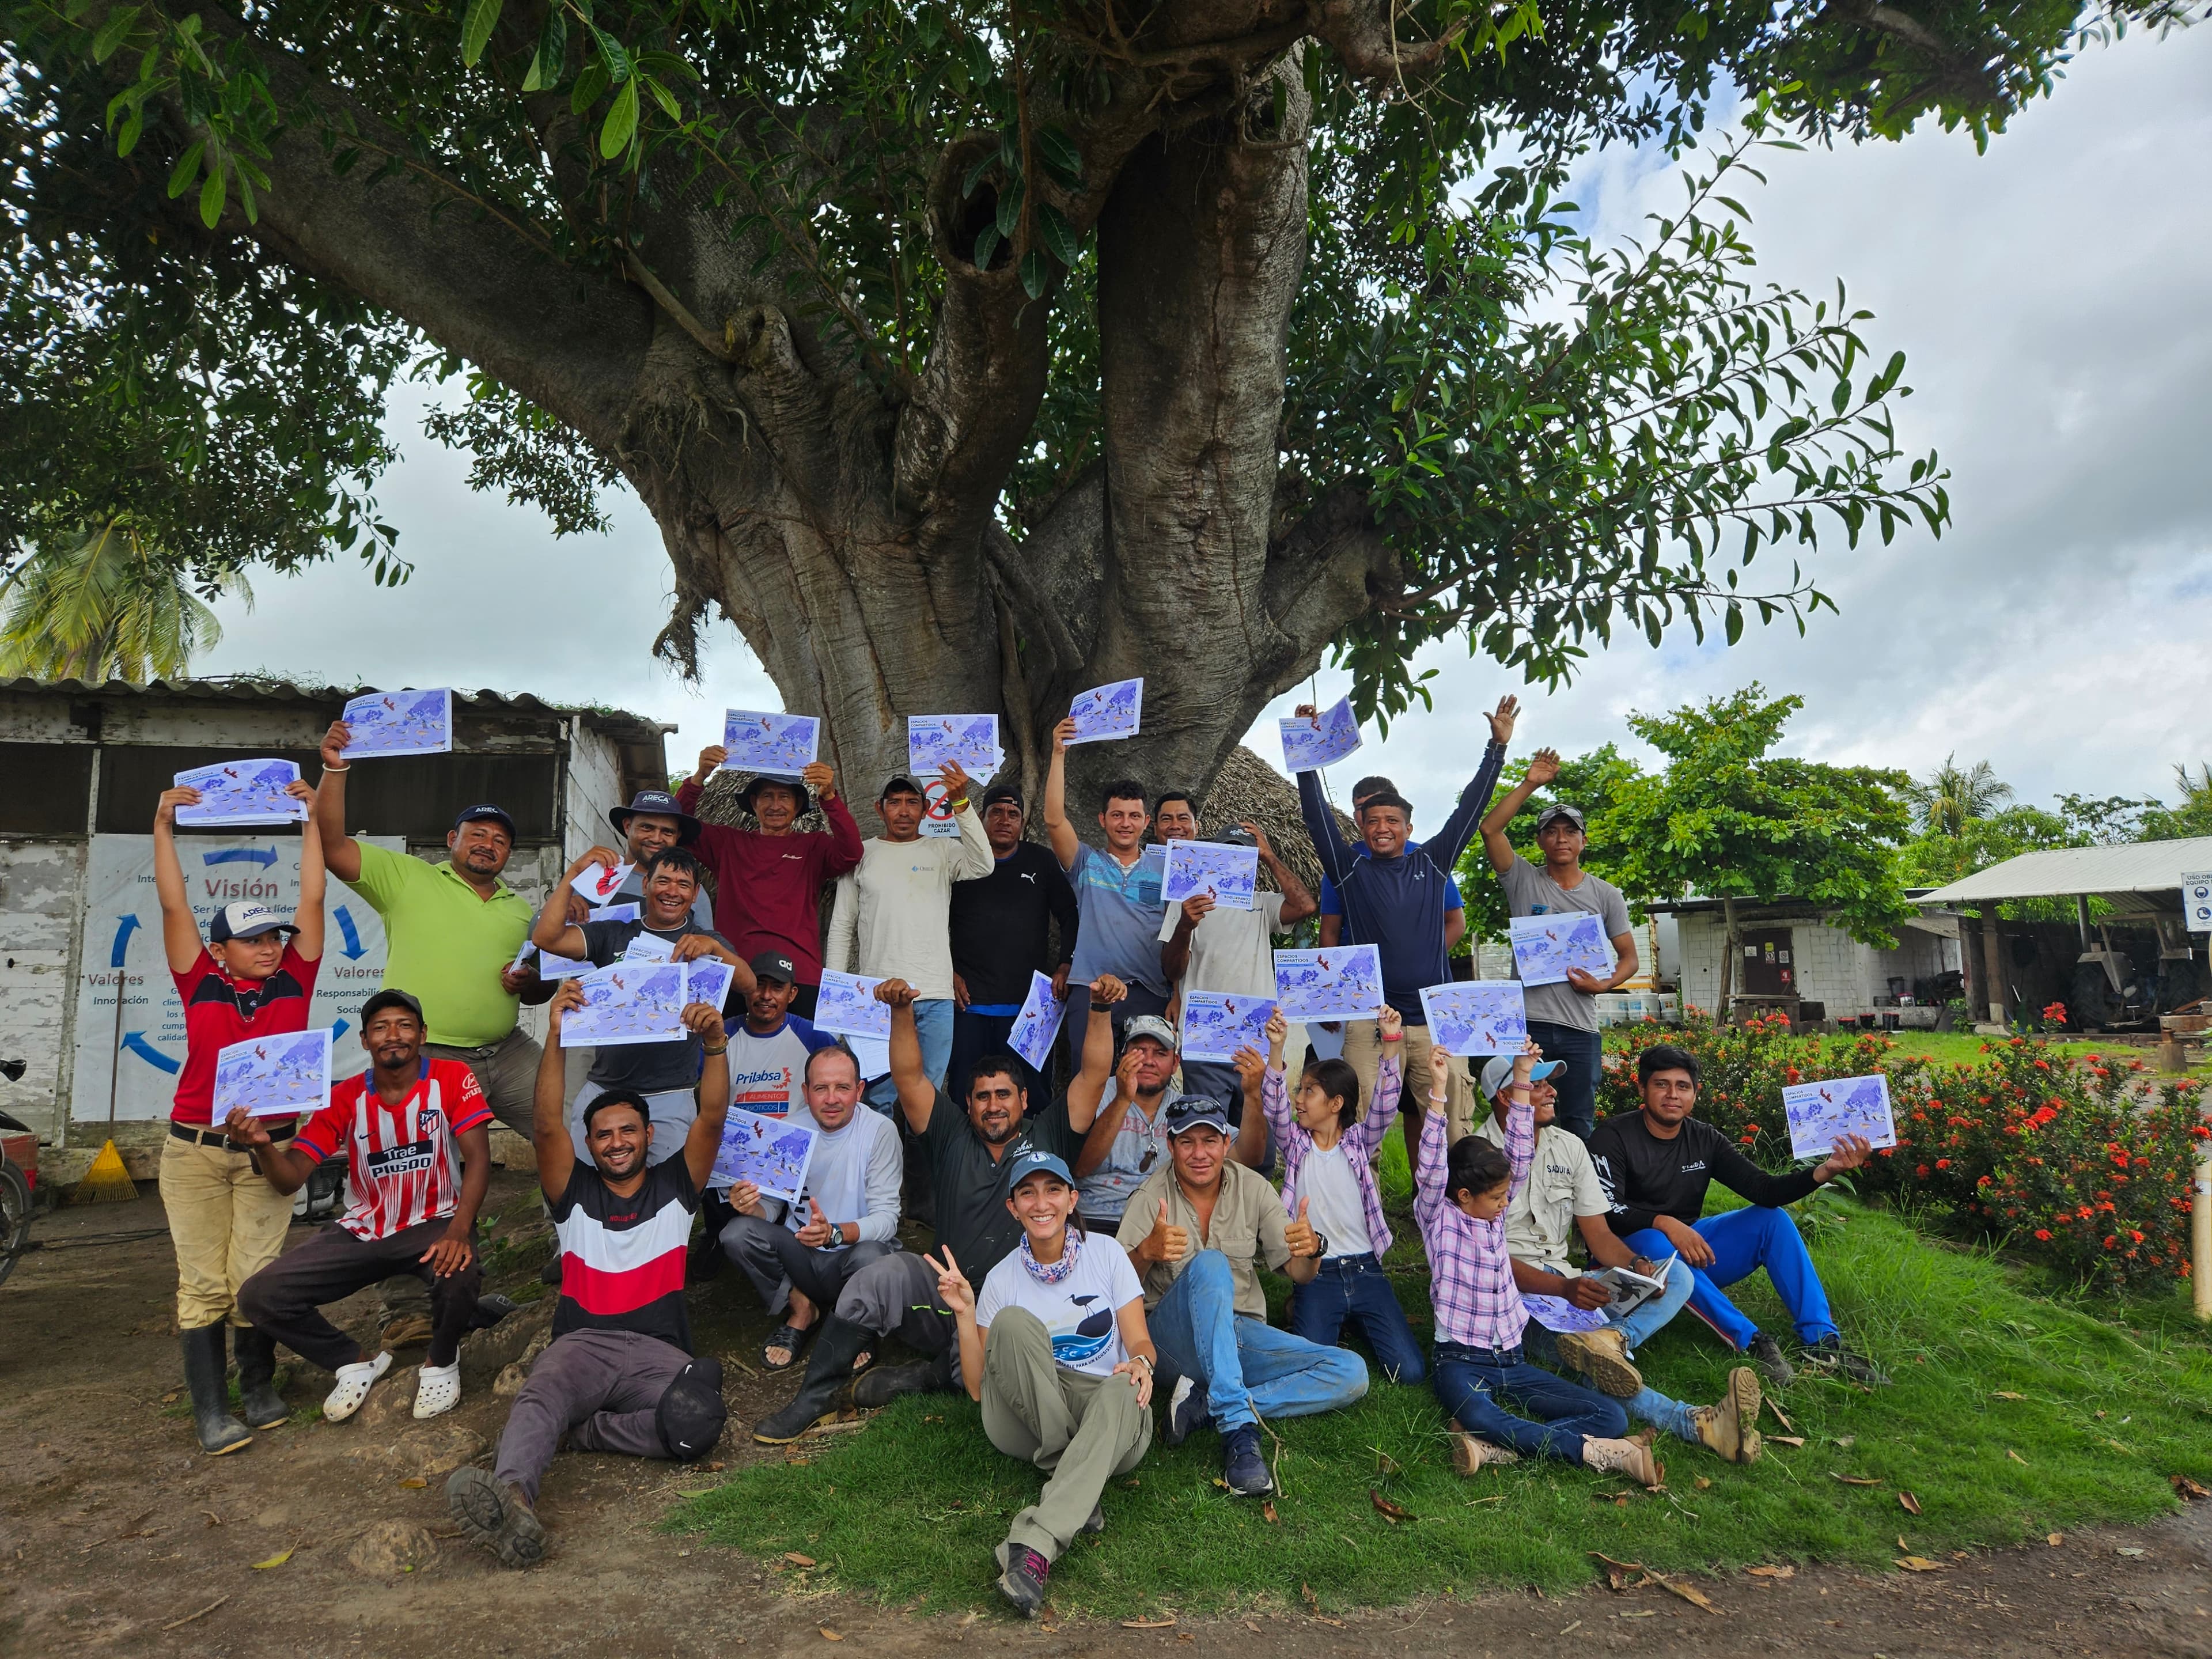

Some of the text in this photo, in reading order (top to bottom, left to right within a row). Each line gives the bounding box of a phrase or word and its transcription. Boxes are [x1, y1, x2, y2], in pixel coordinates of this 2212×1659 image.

[204, 877, 278, 899] Visión
[193, 906, 210, 914] Ser
[274, 904, 297, 914] líder
[631, 946, 652, 955] ESPACIOS
[824, 977, 849, 985] COMPARTIDOS
[162, 998, 183, 1006] clien
[337, 1005, 362, 1014] Socia
[736, 1070, 781, 1085] Prilabsa
